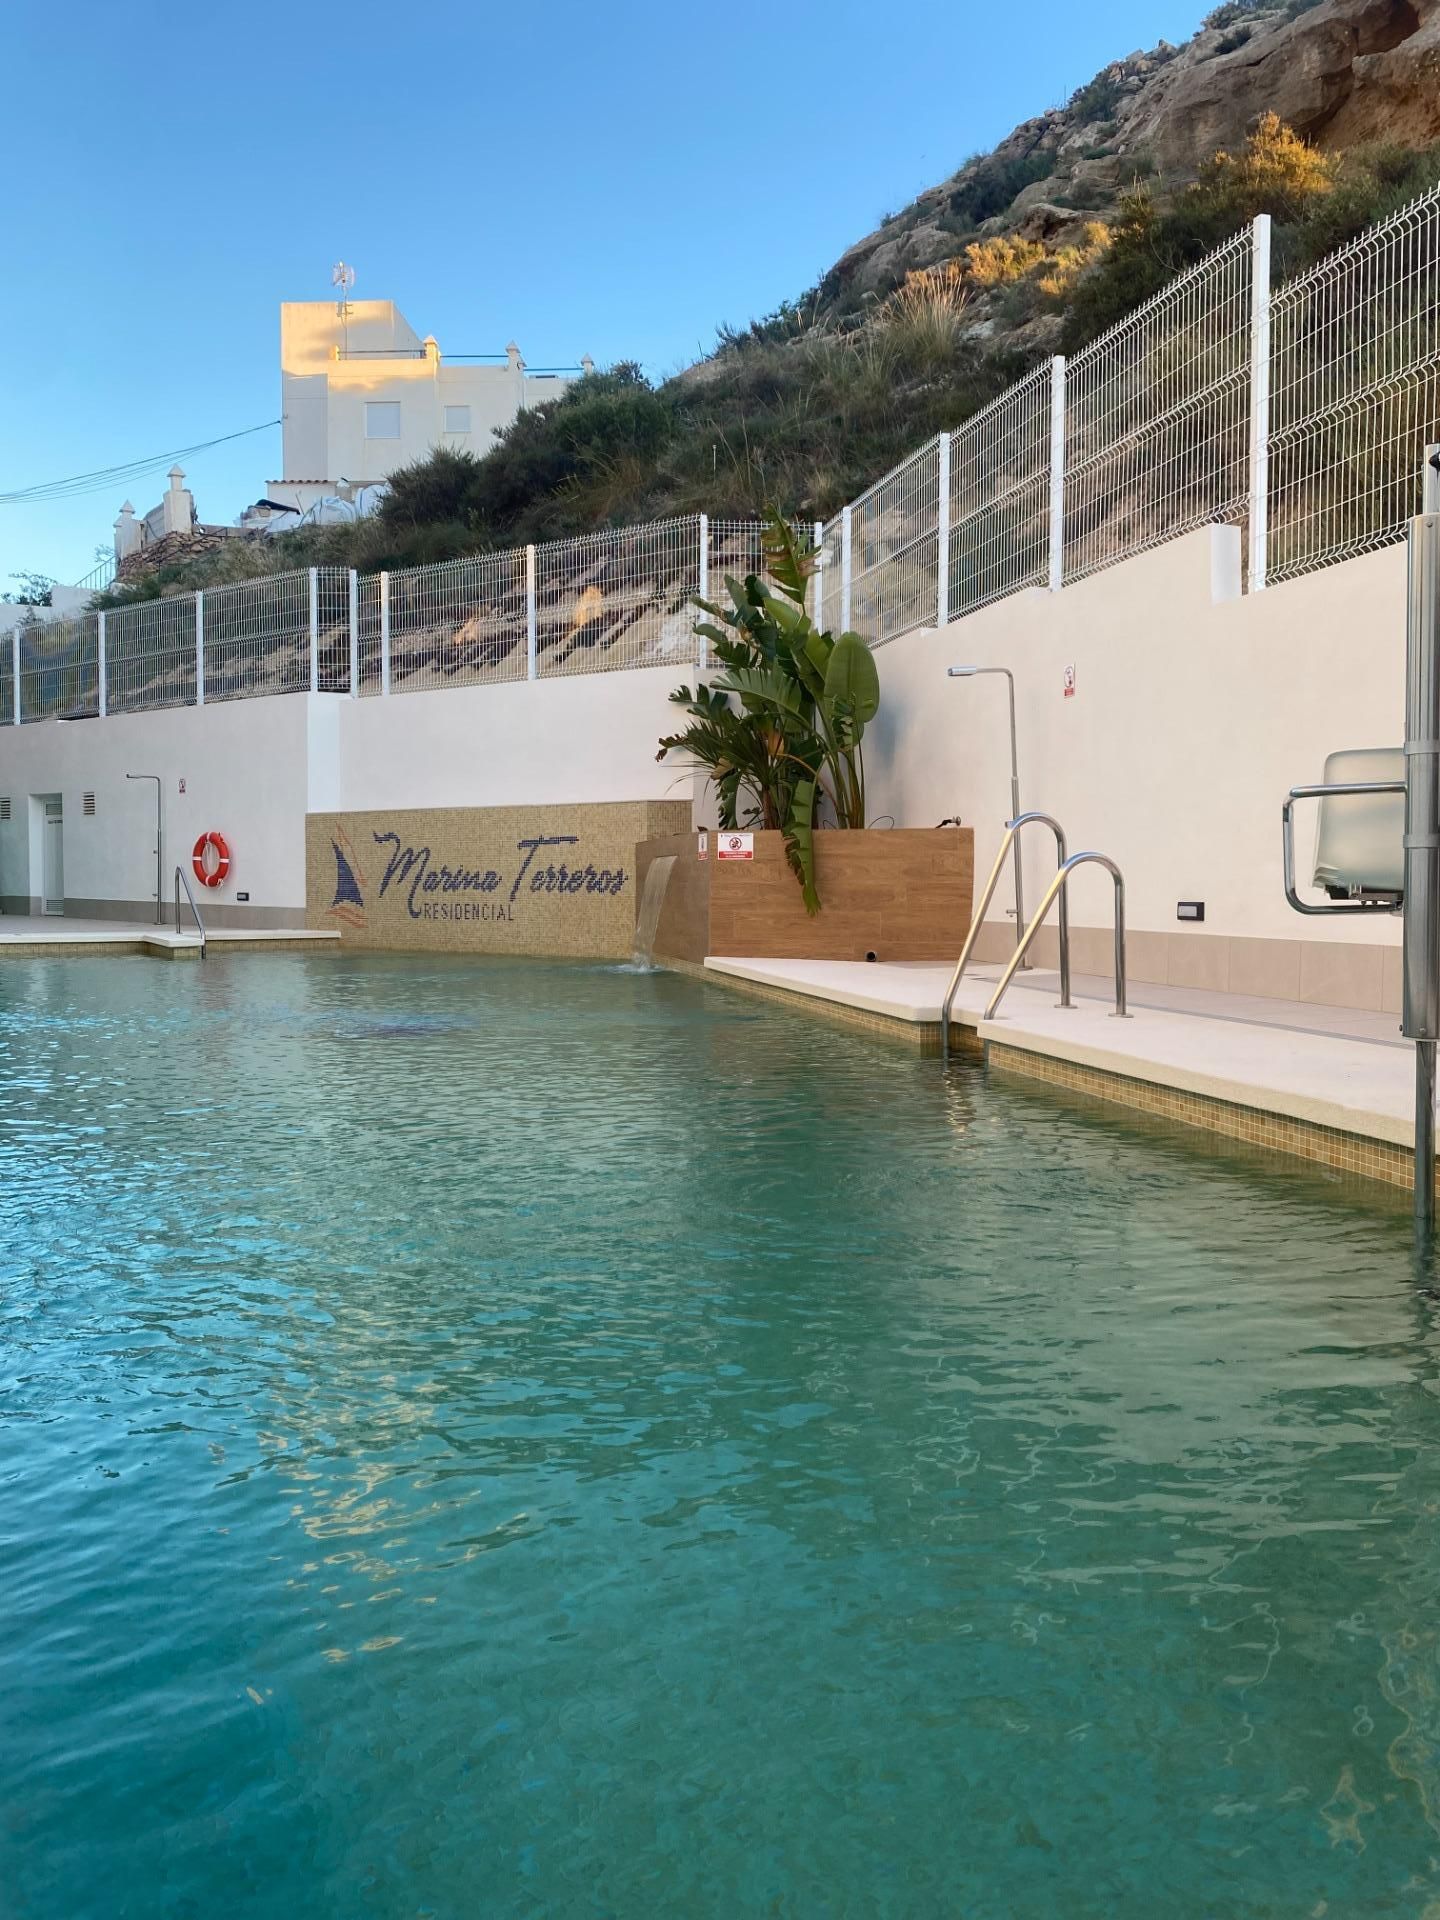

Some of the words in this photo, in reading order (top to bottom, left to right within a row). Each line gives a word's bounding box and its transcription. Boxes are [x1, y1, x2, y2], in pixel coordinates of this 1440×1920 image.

[373, 831, 502, 918] Marina
[509, 835, 628, 901] Terreros
[423, 903, 514, 920] RESIDENCIAL
